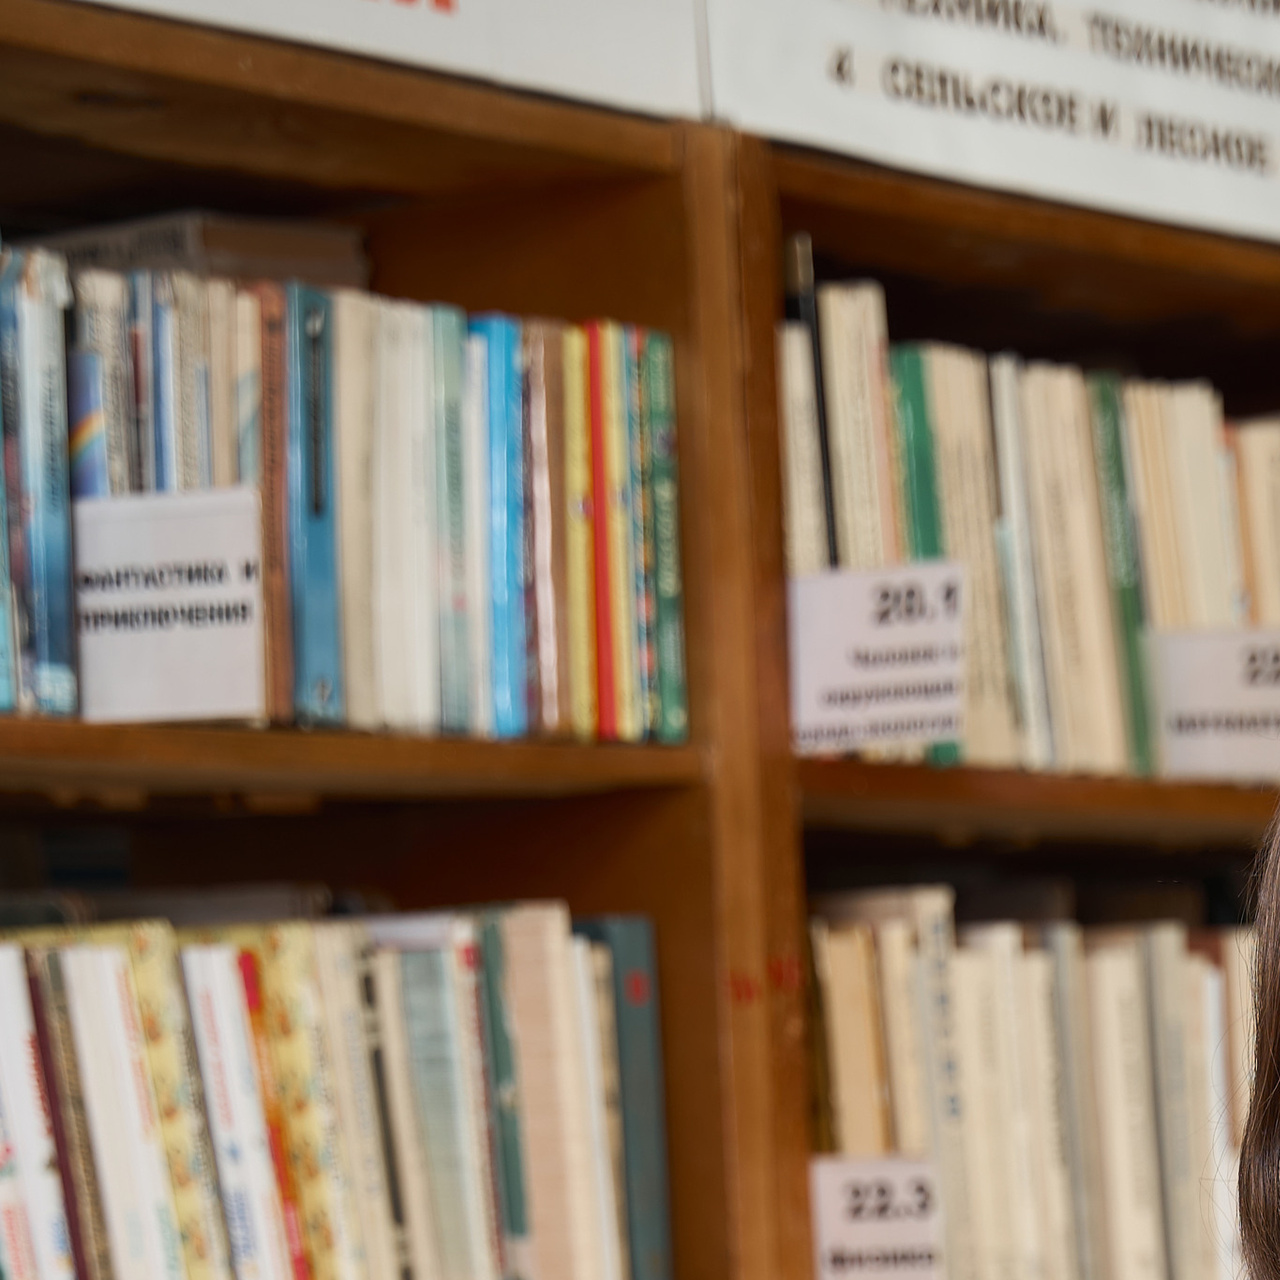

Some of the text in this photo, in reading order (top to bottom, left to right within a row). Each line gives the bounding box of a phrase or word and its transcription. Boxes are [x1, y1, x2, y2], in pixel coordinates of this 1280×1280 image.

[880, 56, 1081, 136] СЕЛЬСКОЕ
[1134, 108, 1270, 176] ЛЕСНОЕ
[79, 564, 229, 591] ФАНТАСТИКА
[849, 1182, 932, 1218] 22.3
